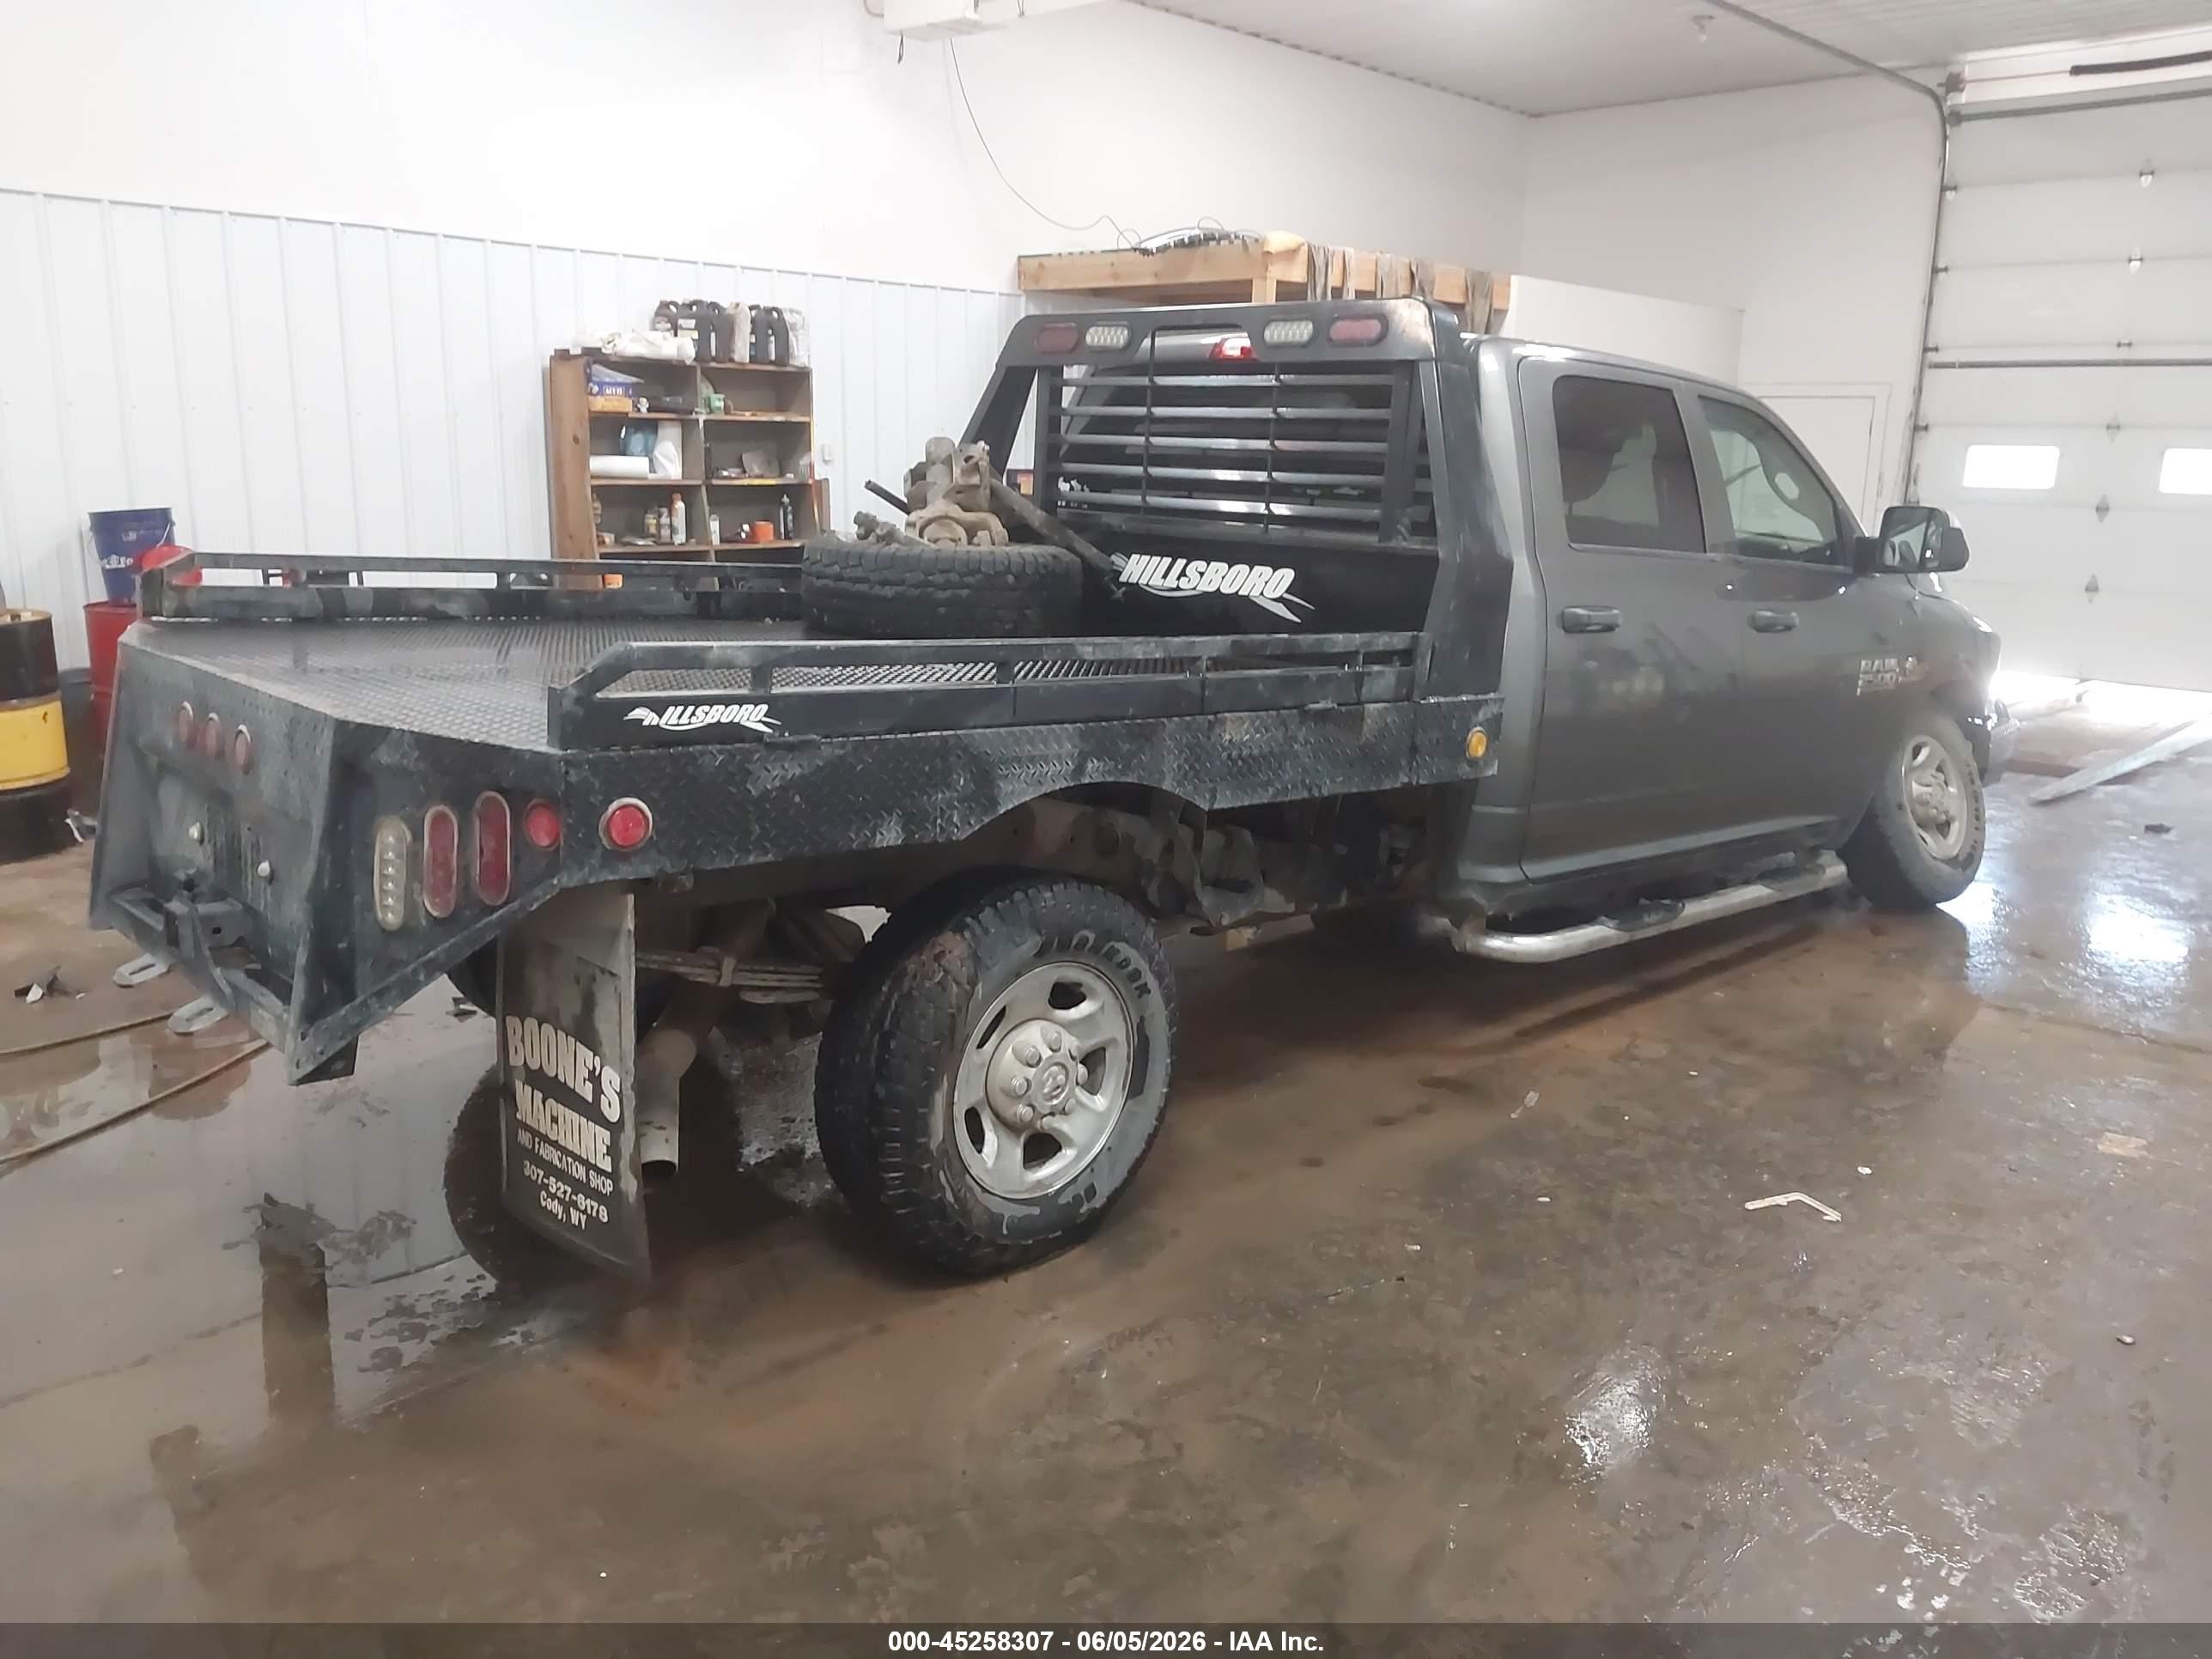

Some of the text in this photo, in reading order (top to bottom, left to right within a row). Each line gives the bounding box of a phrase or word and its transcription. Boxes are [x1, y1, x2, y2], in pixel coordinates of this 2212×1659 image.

[1118, 553, 1297, 599] HILLSBORO
[505, 1016, 621, 1124] BOONE'S
[515, 1079, 612, 1173] MACHINE
[534, 1136, 587, 1183] FABRICATION
[589, 1169, 614, 1196] SHOP
[539, 1190, 587, 1231] Cody, WY
